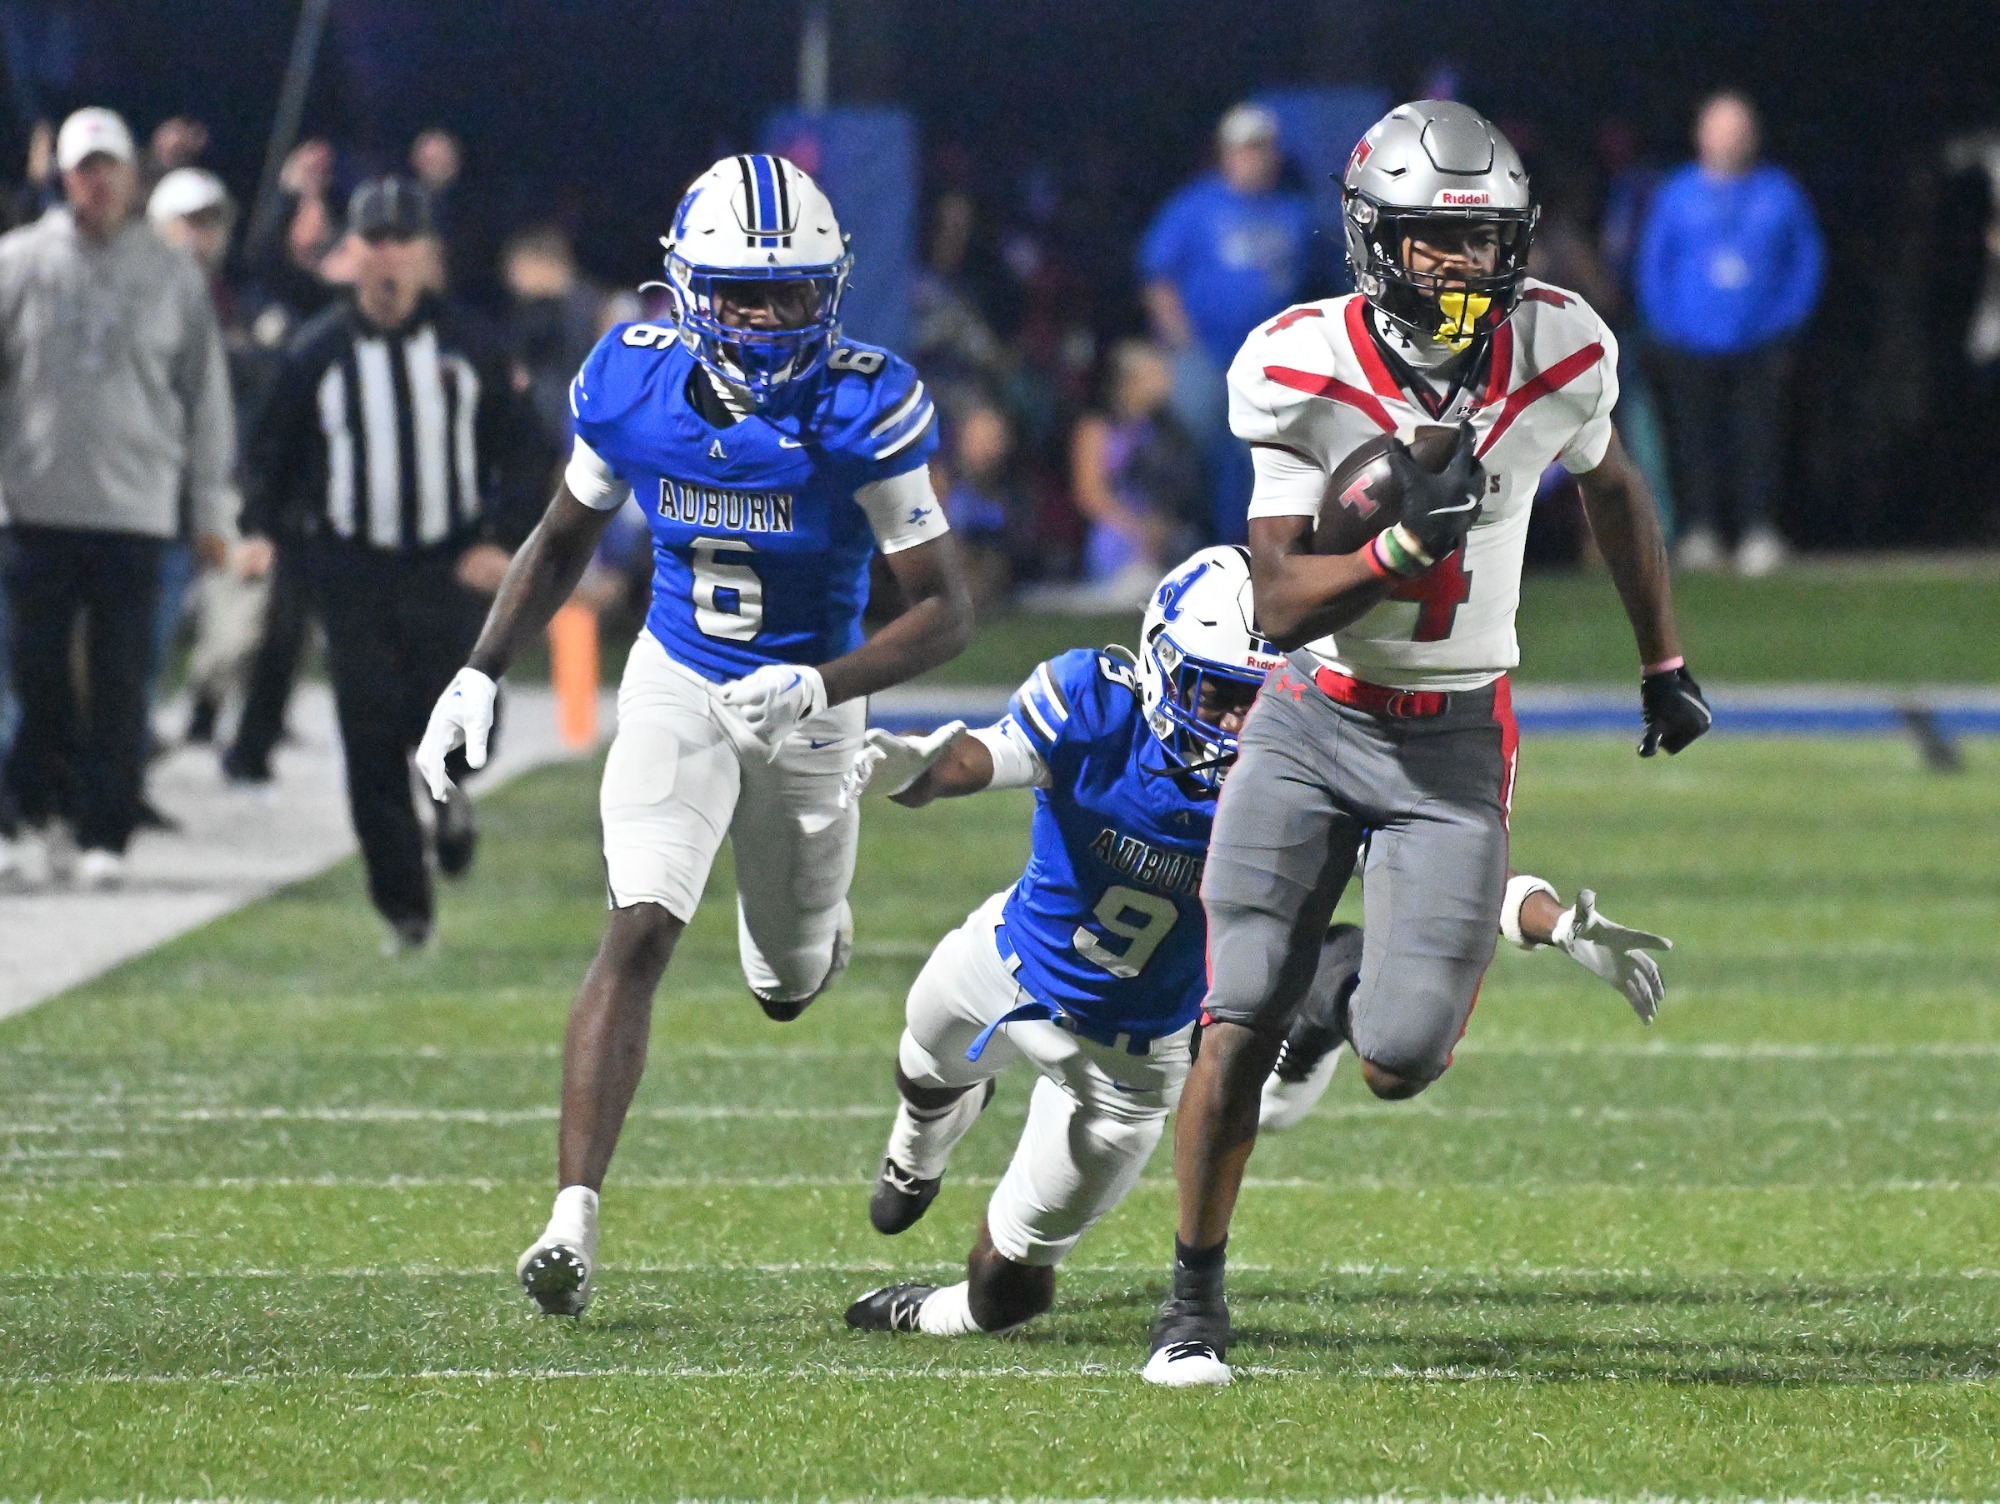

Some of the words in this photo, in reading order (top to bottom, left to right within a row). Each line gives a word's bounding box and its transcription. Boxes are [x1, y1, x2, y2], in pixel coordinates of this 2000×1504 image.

[1443, 193, 1489, 204] Riddell
[622, 323, 679, 350] 6
[827, 348, 886, 375] 6
[709, 439, 727, 459] A
[657, 478, 793, 533] AUBURN
[689, 536, 763, 642] 6
[1392, 532, 1473, 642] 4
[1247, 656, 1276, 670] Ridd
[1089, 828, 1206, 896] AUBUR
[1072, 885, 1180, 979] 9
